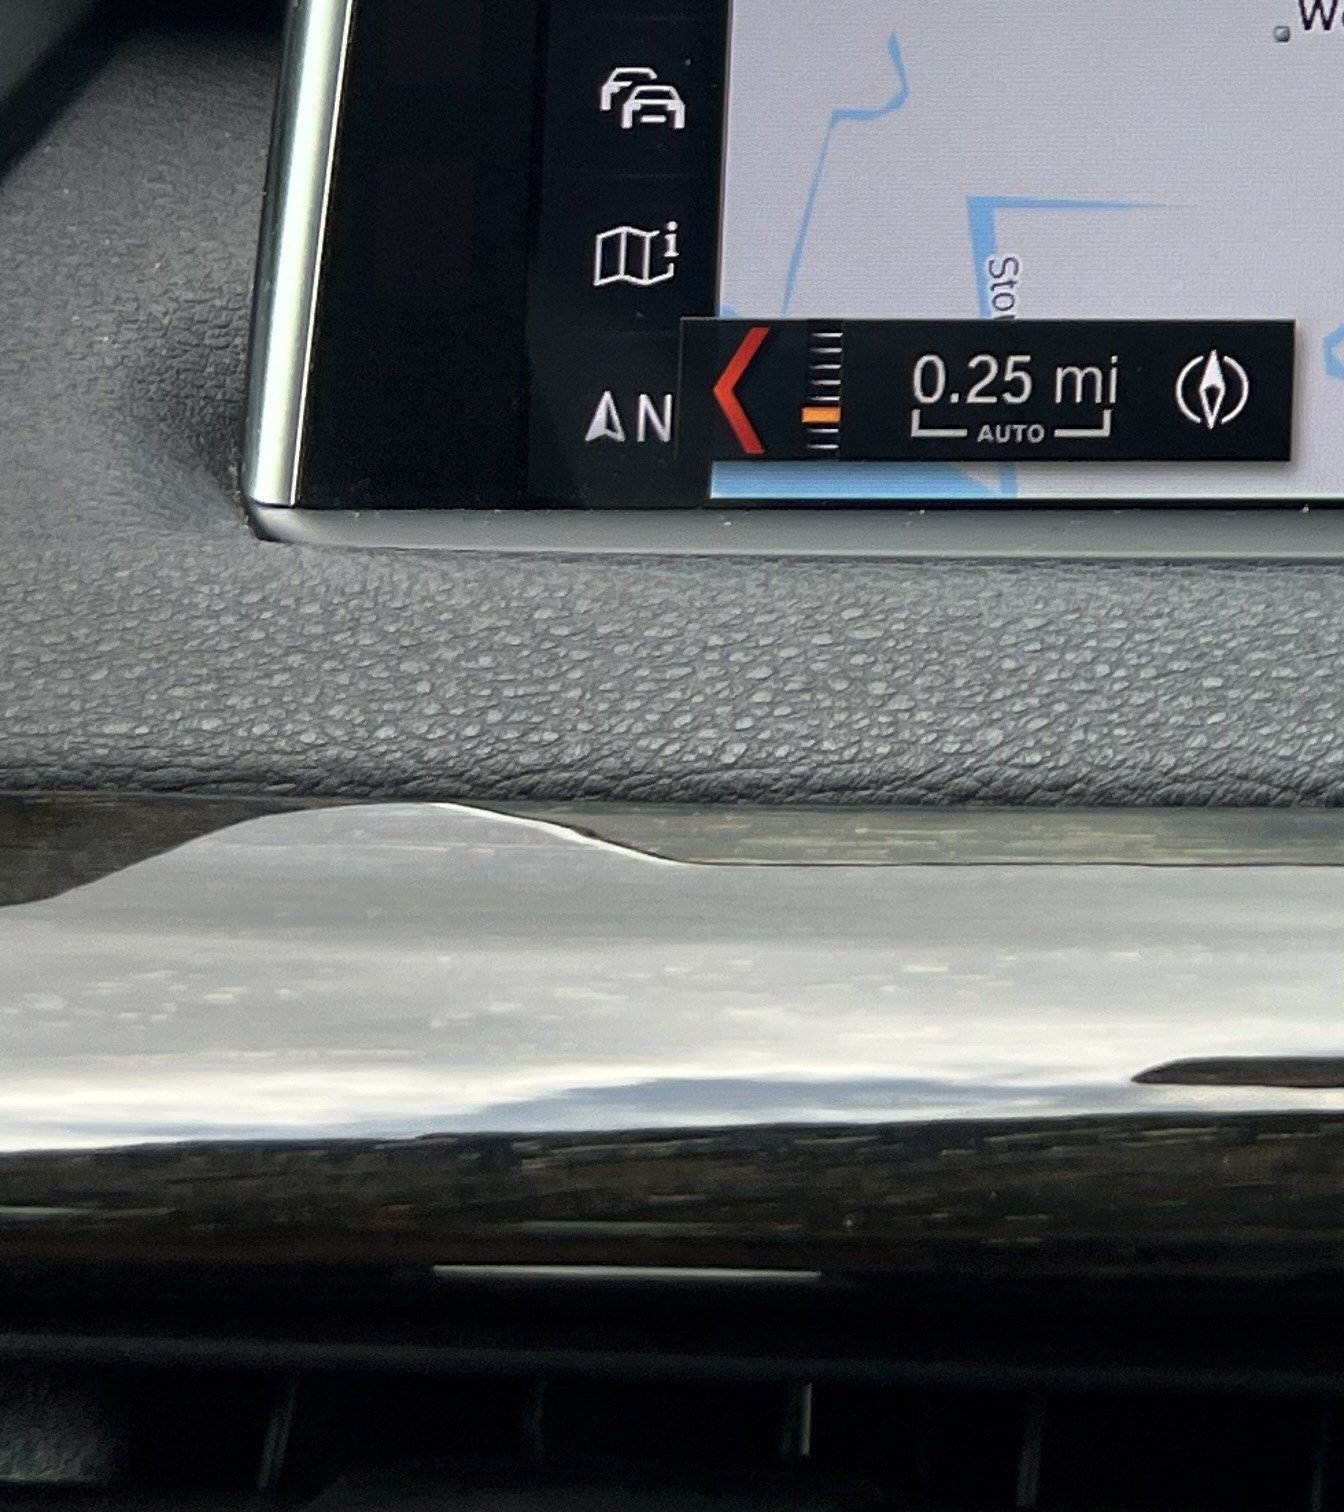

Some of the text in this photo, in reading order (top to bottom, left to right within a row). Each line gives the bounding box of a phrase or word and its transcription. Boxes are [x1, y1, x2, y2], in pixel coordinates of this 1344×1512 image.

[988, 256, 1019, 320] Sto
[912, 354, 1119, 405] 0.25 mi
[637, 393, 673, 442] N
[976, 424, 1046, 444] AUTO
